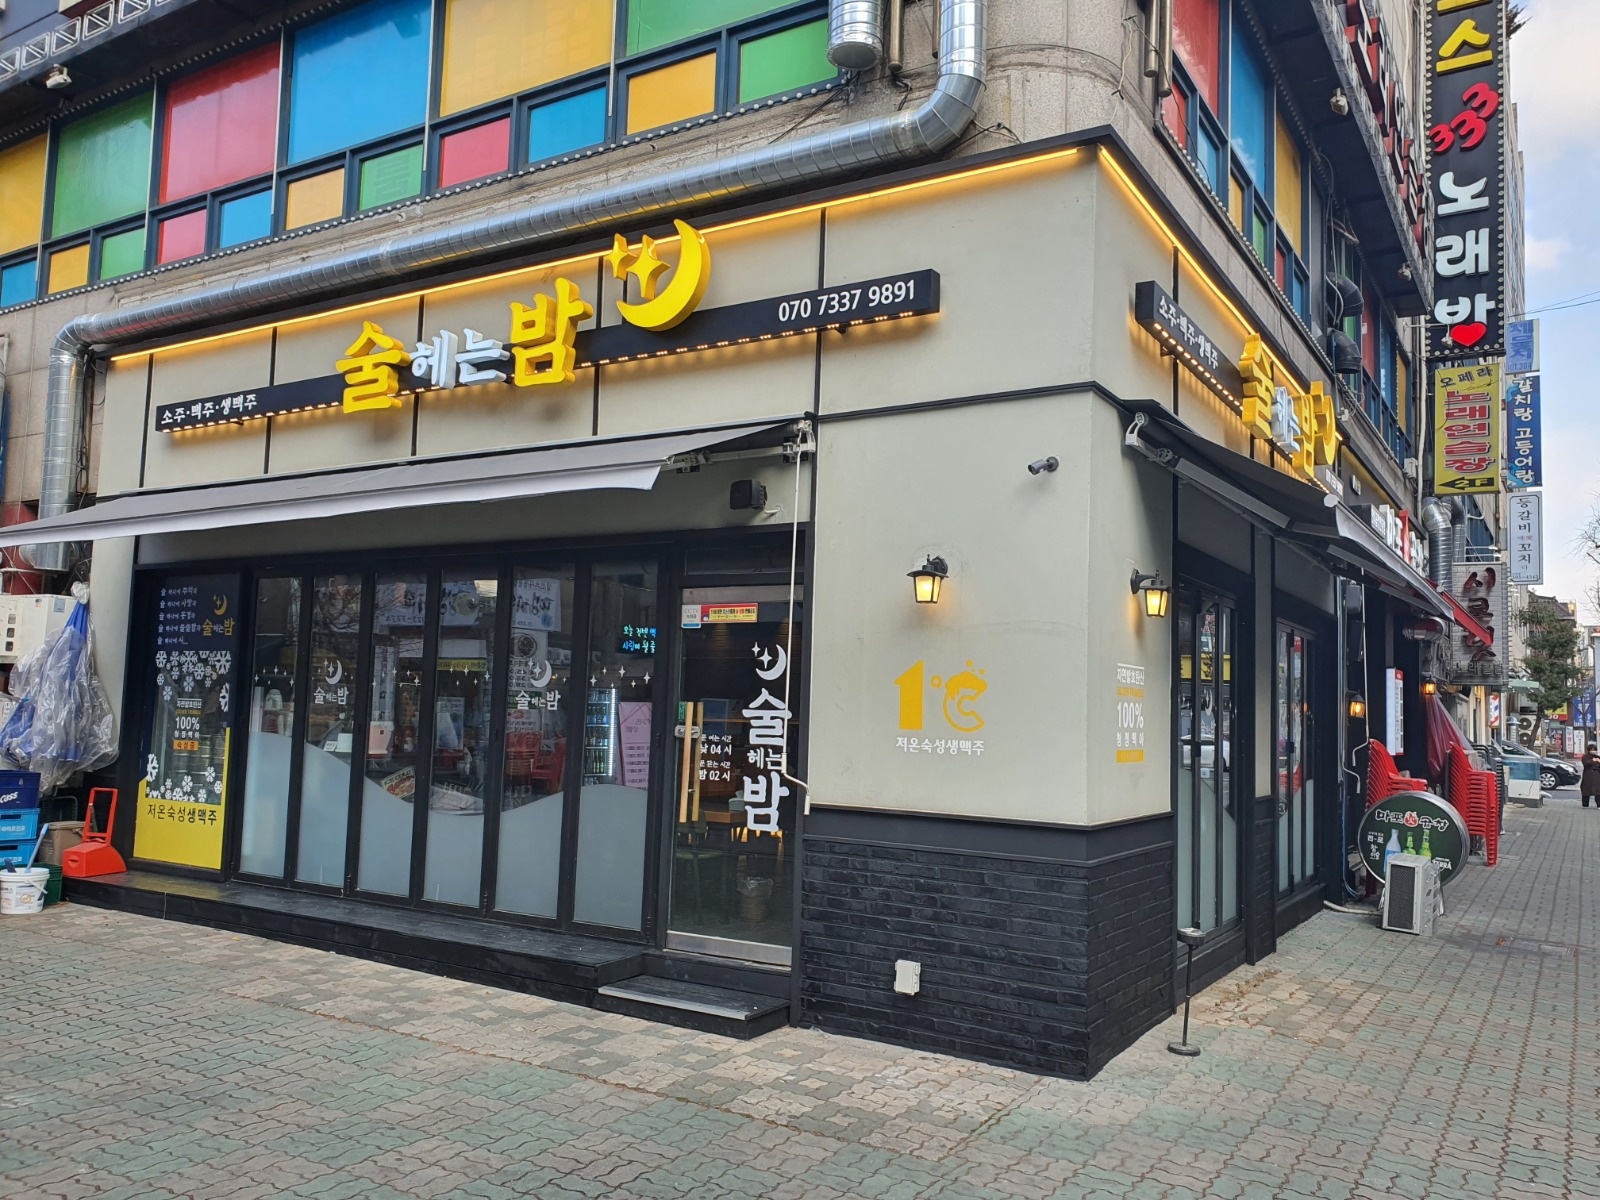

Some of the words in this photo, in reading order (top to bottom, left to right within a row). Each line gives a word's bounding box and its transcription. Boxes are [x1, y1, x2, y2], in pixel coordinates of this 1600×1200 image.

[778, 298, 812, 322] 070
[817, 288, 863, 316] 7337
[868, 279, 915, 307] 9891
[1440, 366, 1493, 389] 오페라
[1443, 390, 1496, 474] 노래연습장
[1454, 478, 1488, 488] 2F
[175, 716, 200, 730] 100%
[1116, 702, 1144, 729] 100%
[710, 744, 722, 755] 04
[709, 770, 720, 781] 02
[147, 803, 217, 826] 저온숙성생맥주
